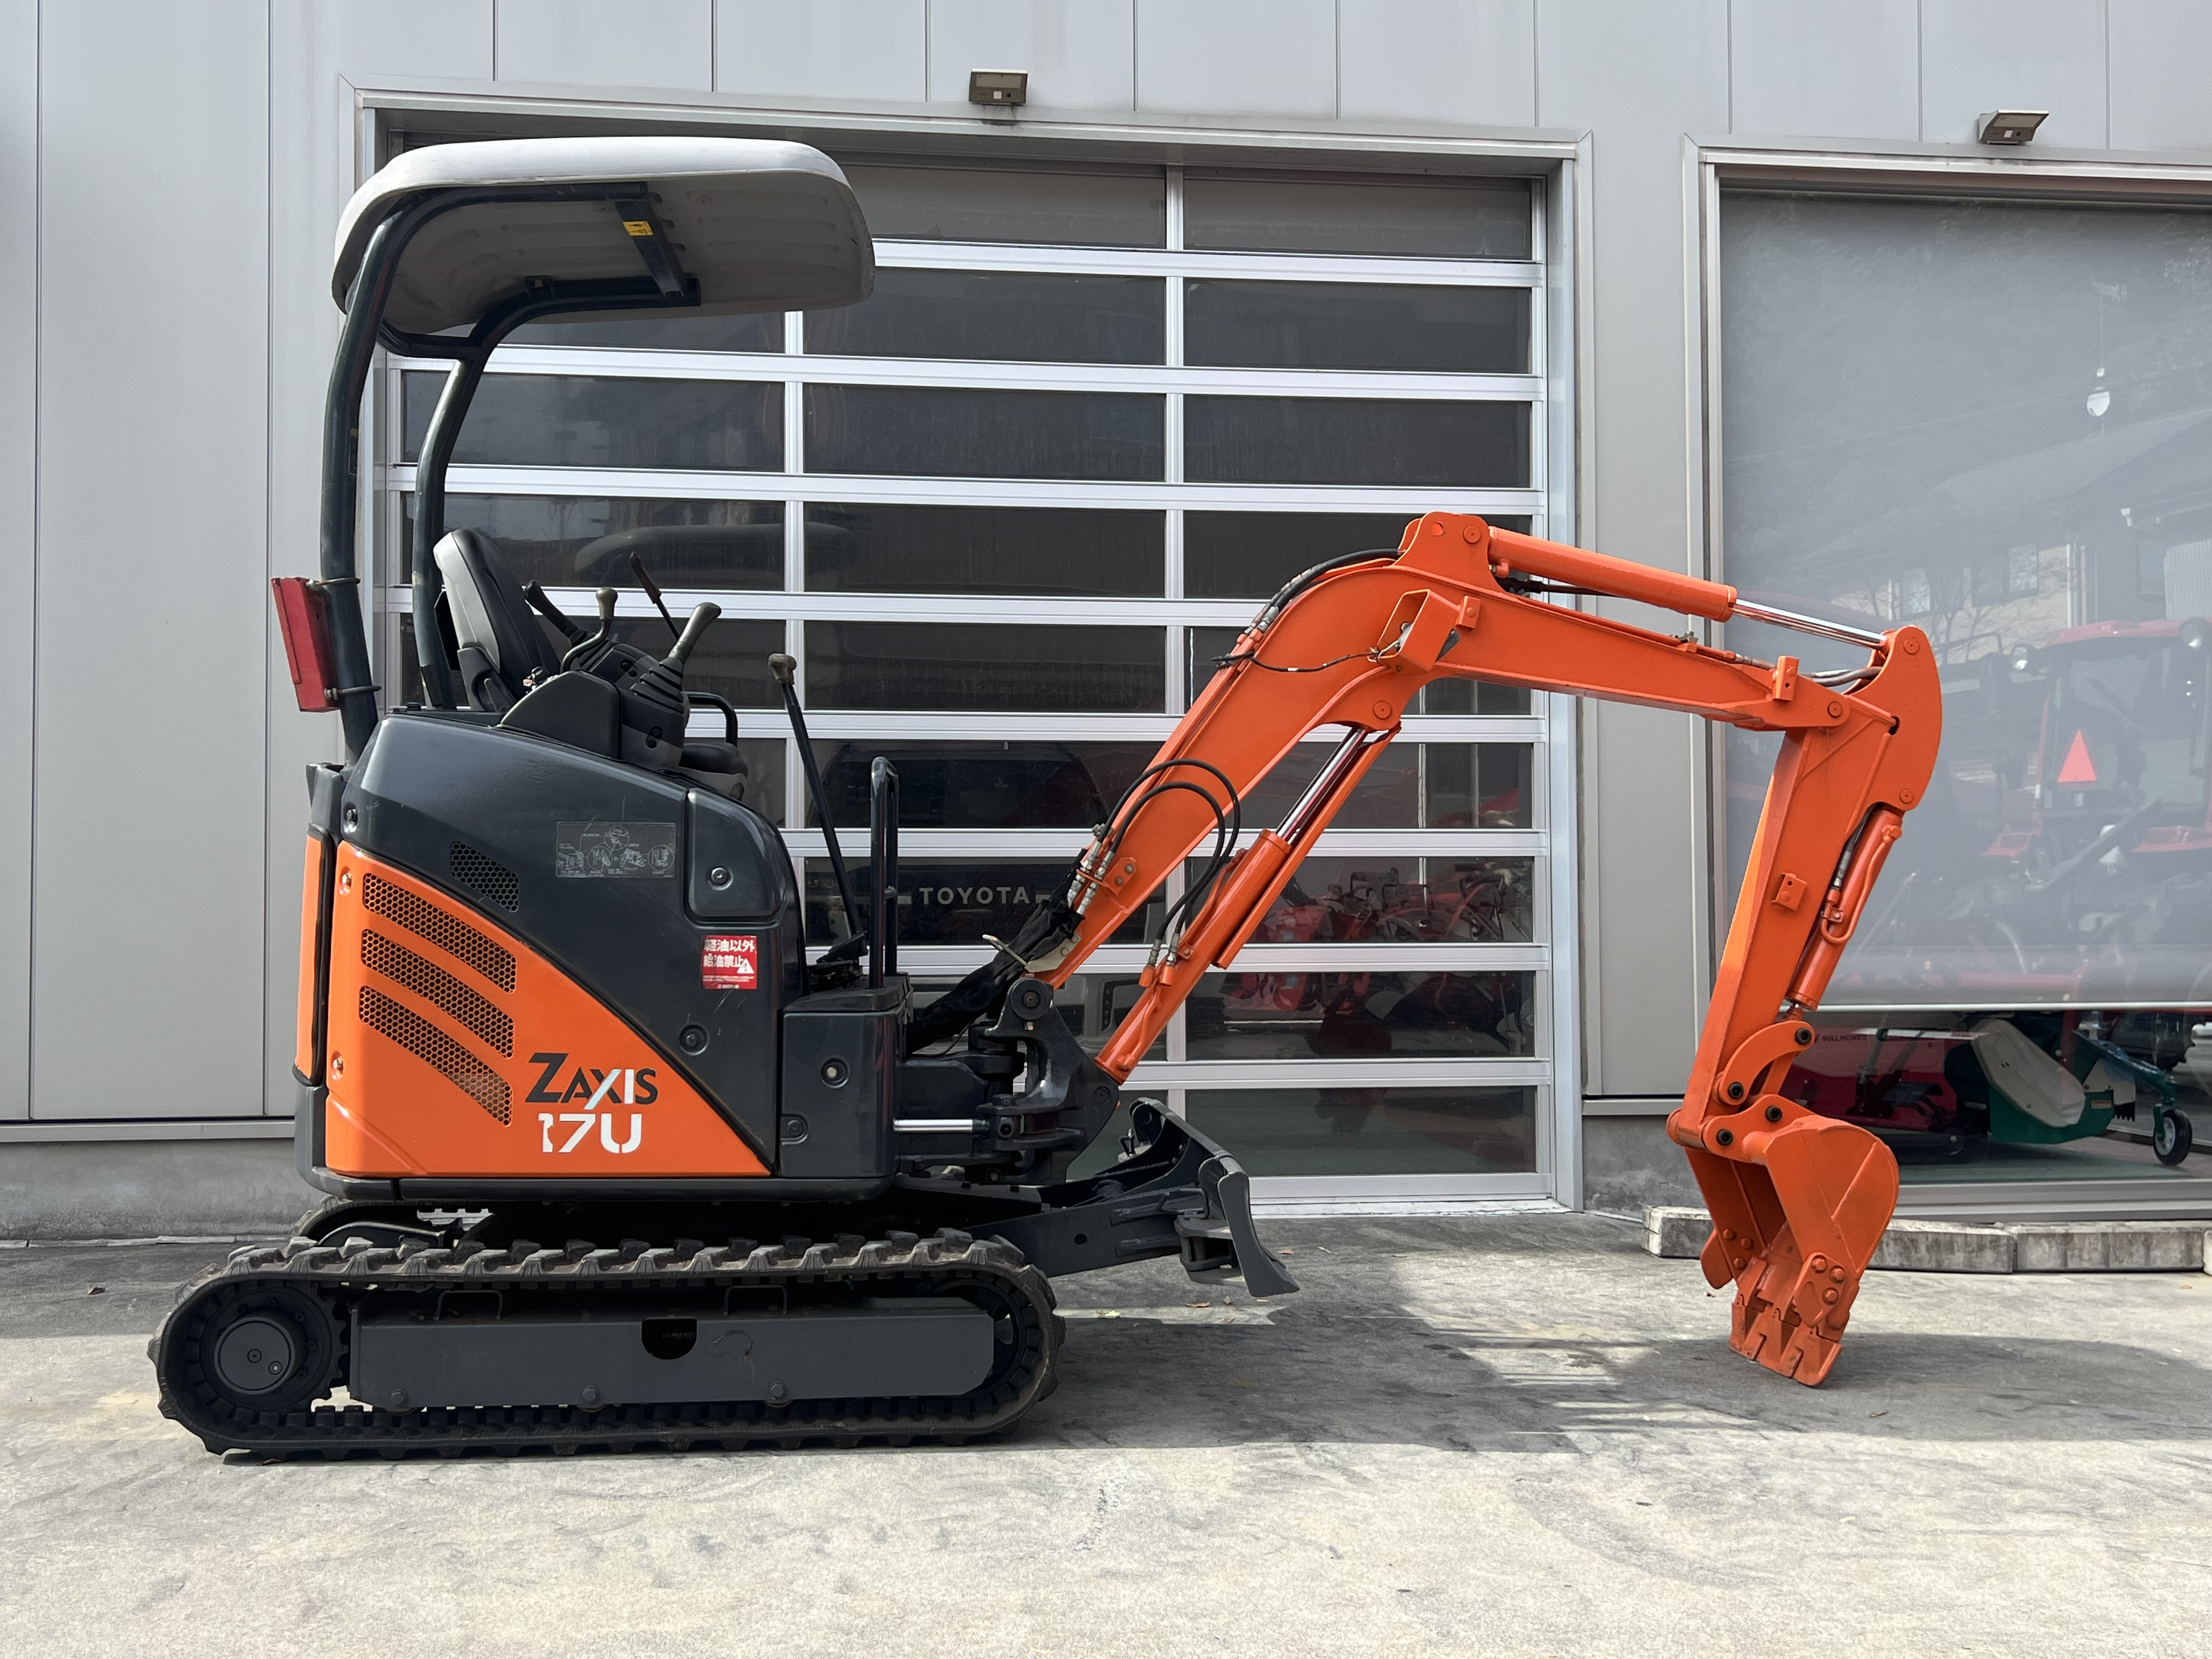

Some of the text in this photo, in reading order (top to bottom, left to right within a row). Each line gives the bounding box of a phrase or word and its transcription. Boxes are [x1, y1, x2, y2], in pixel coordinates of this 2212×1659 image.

[919, 887, 1030, 904] TOYOTA
[704, 939, 755, 952] 軽油以外
[703, 953, 744, 968] 給油禁止
[525, 1052, 658, 1110] ZAXIS
[538, 1113, 642, 1153] 17U
